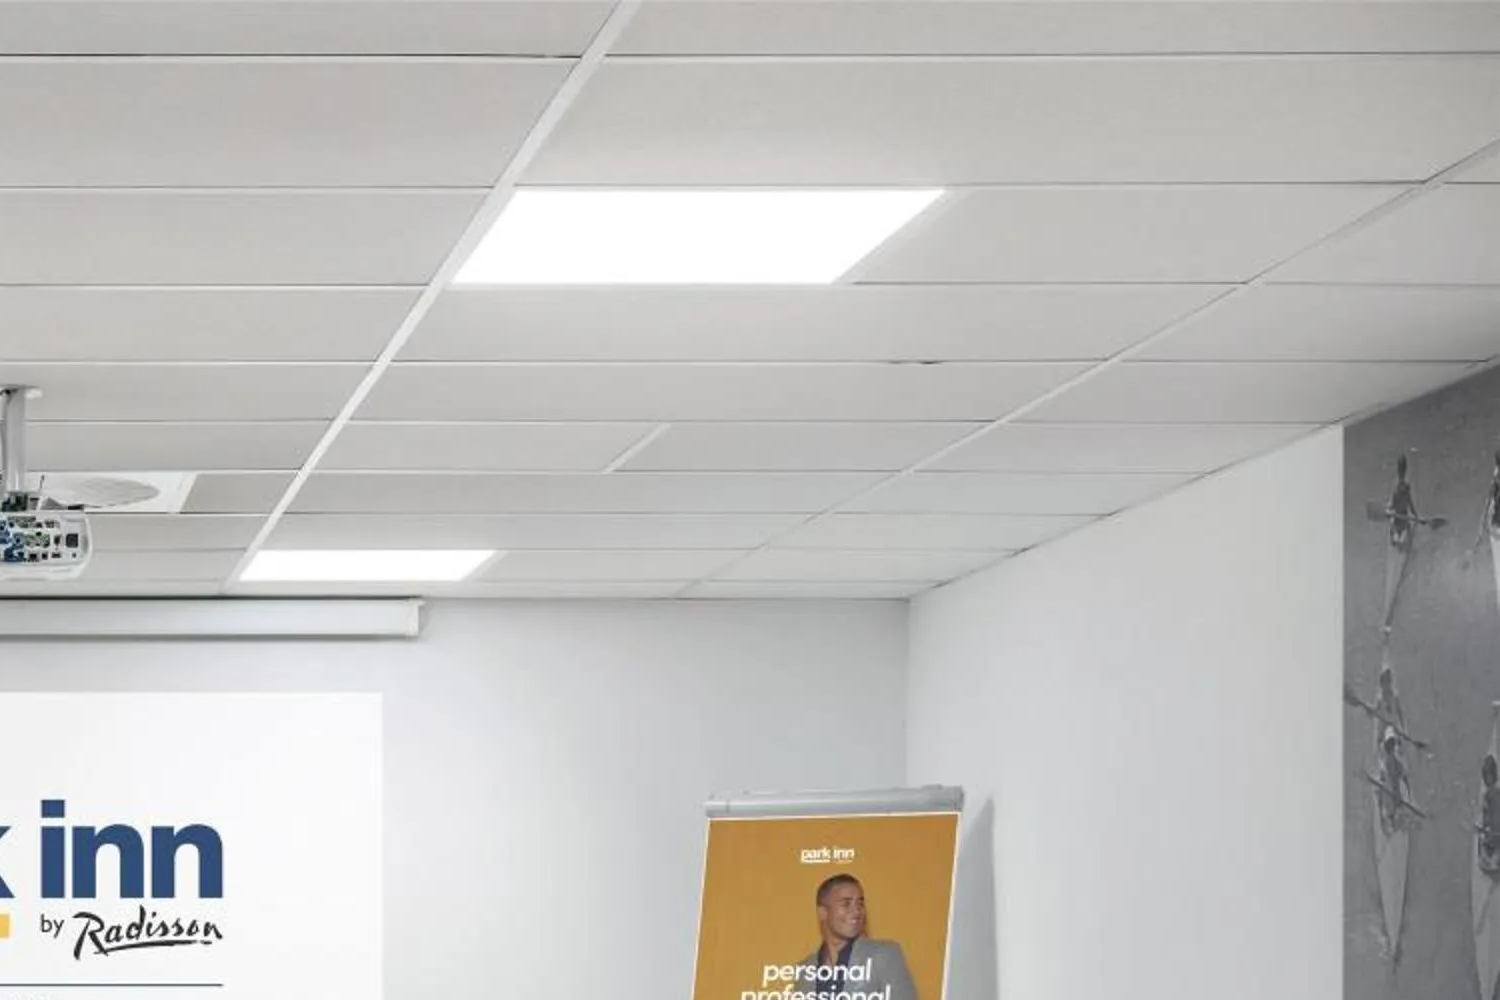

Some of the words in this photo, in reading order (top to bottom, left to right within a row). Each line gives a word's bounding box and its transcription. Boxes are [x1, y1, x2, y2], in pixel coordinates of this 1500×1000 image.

[40, 799, 224, 899] inn
[801, 847, 831, 862] park
[833, 847, 855, 859] inn
[40, 913, 65, 939] by
[72, 904, 223, 961] Radisson
[762, 957, 872, 988] personal
